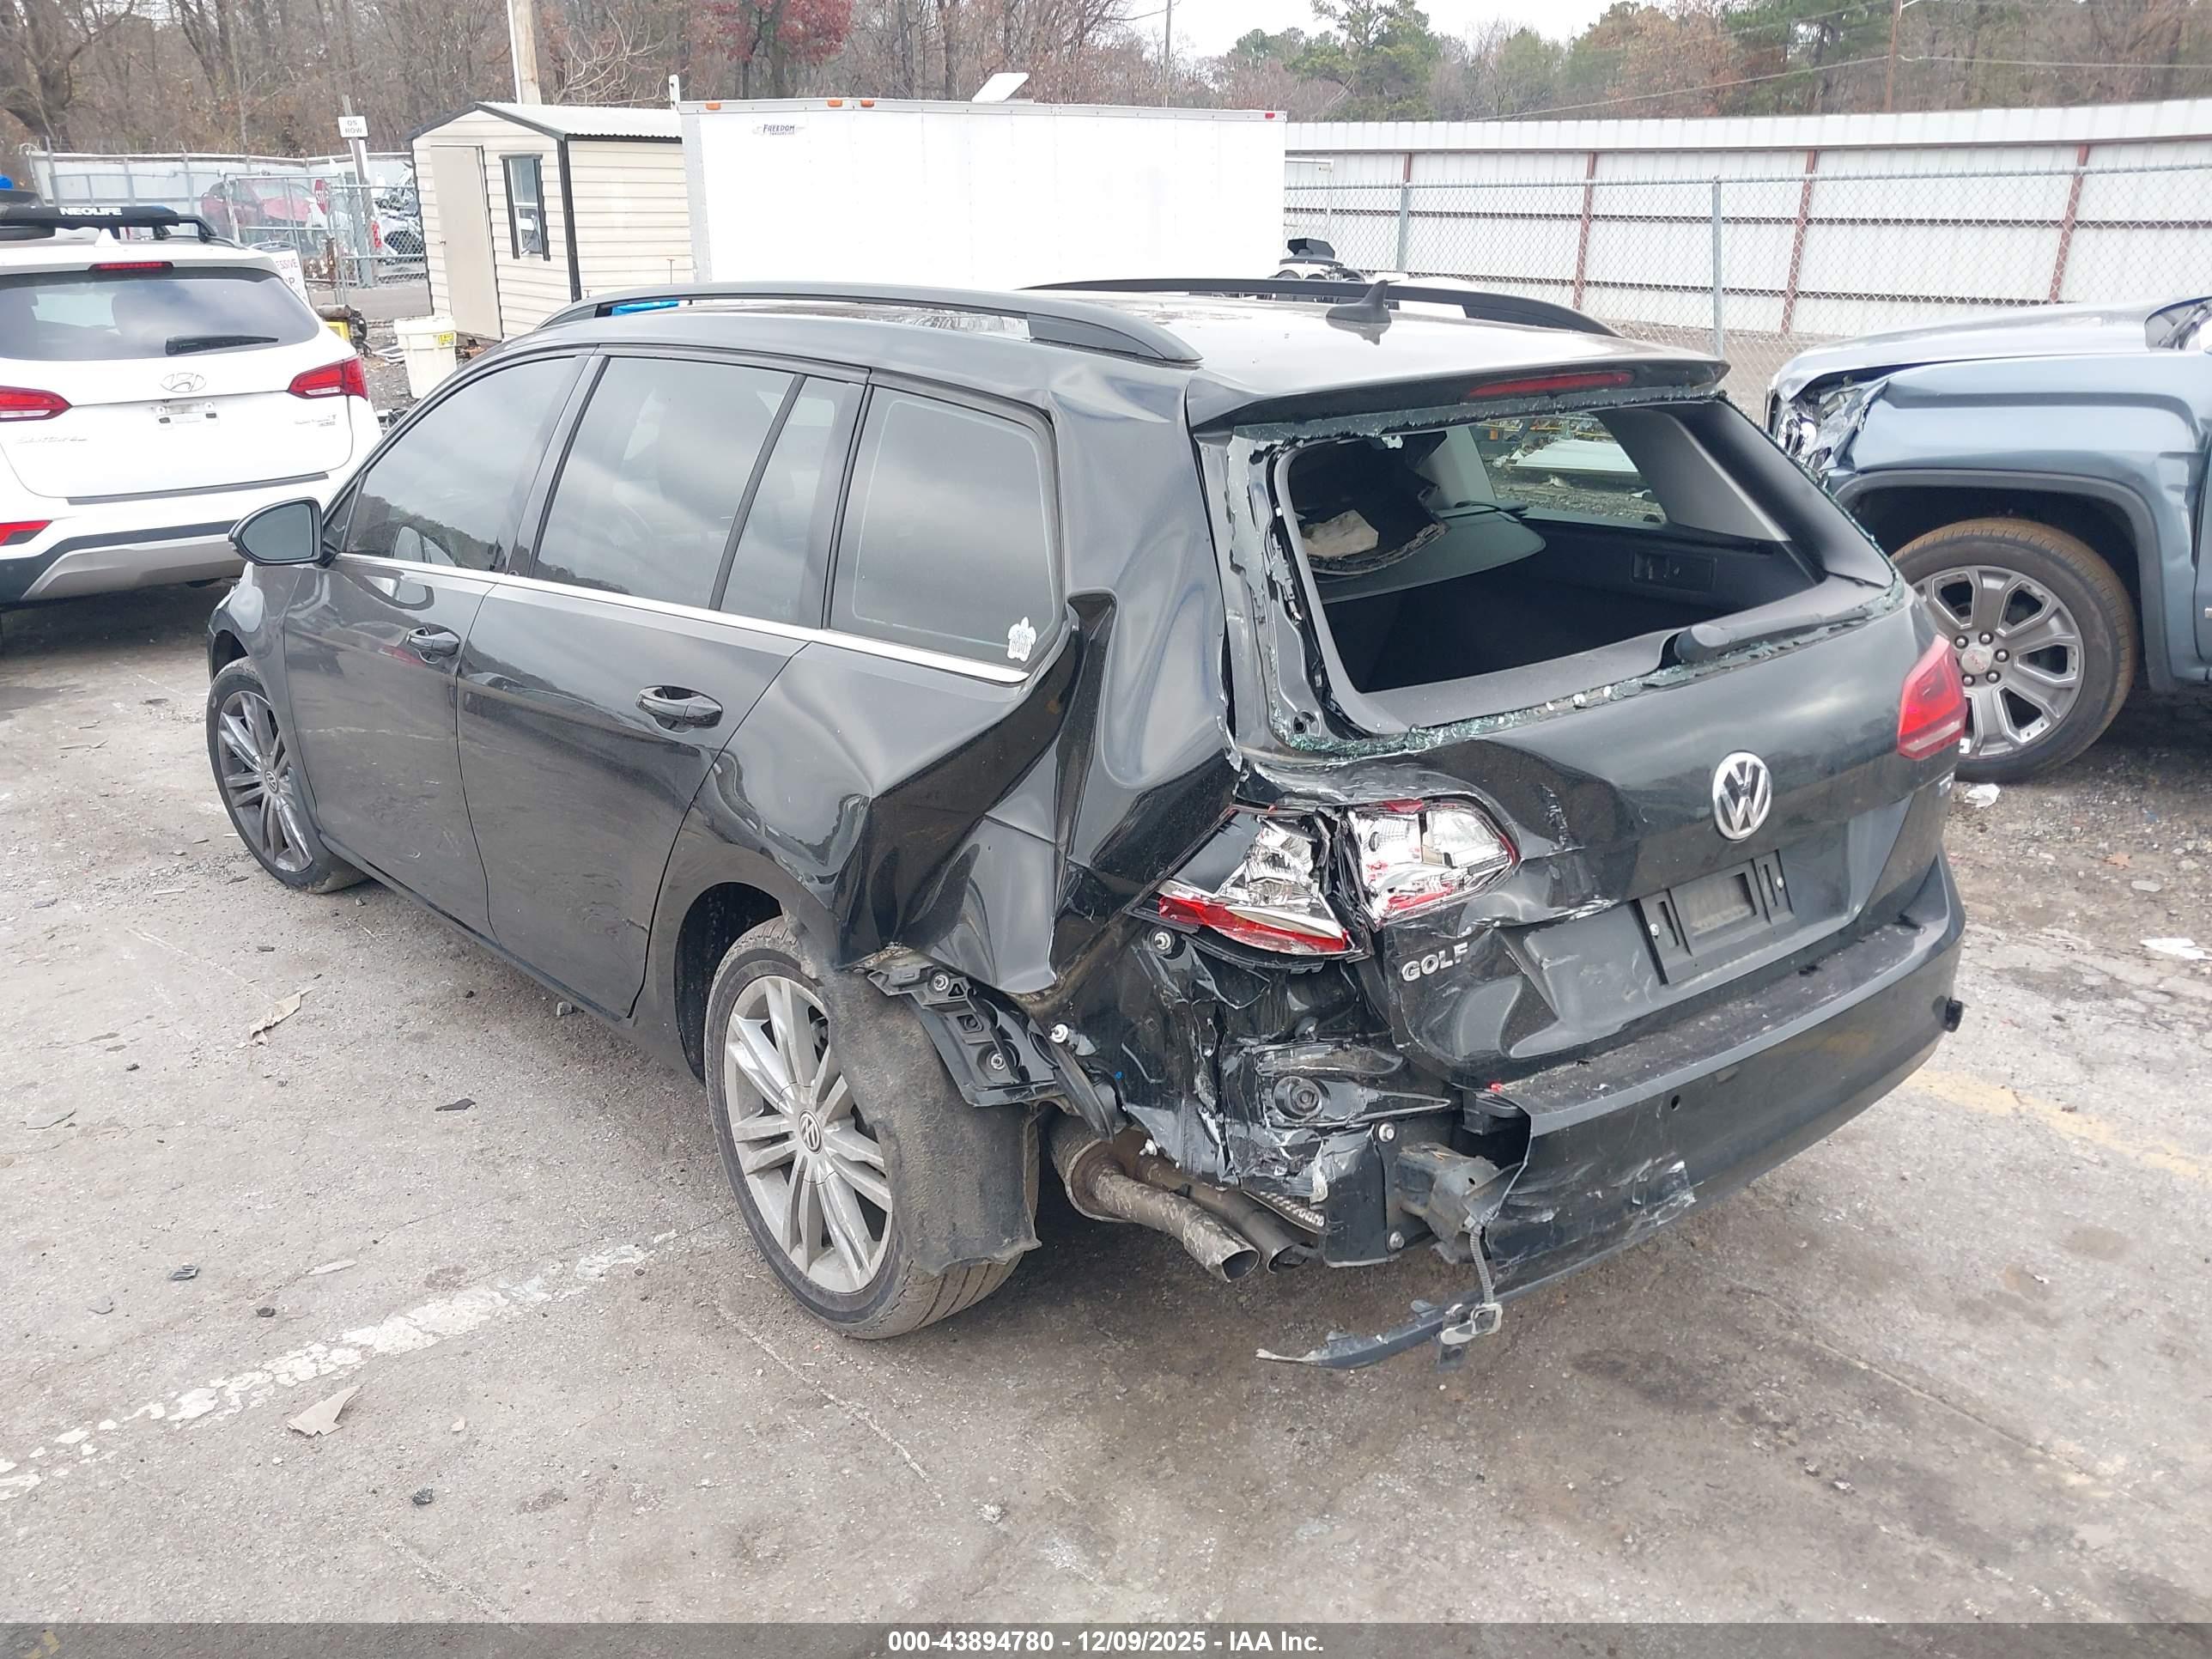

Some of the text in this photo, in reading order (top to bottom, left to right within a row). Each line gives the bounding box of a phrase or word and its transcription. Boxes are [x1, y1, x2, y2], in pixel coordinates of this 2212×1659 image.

[763, 124, 795, 133] FREEDOM
[58, 207, 123, 216] NEOLIFE
[1401, 942, 1468, 981] GOLF
